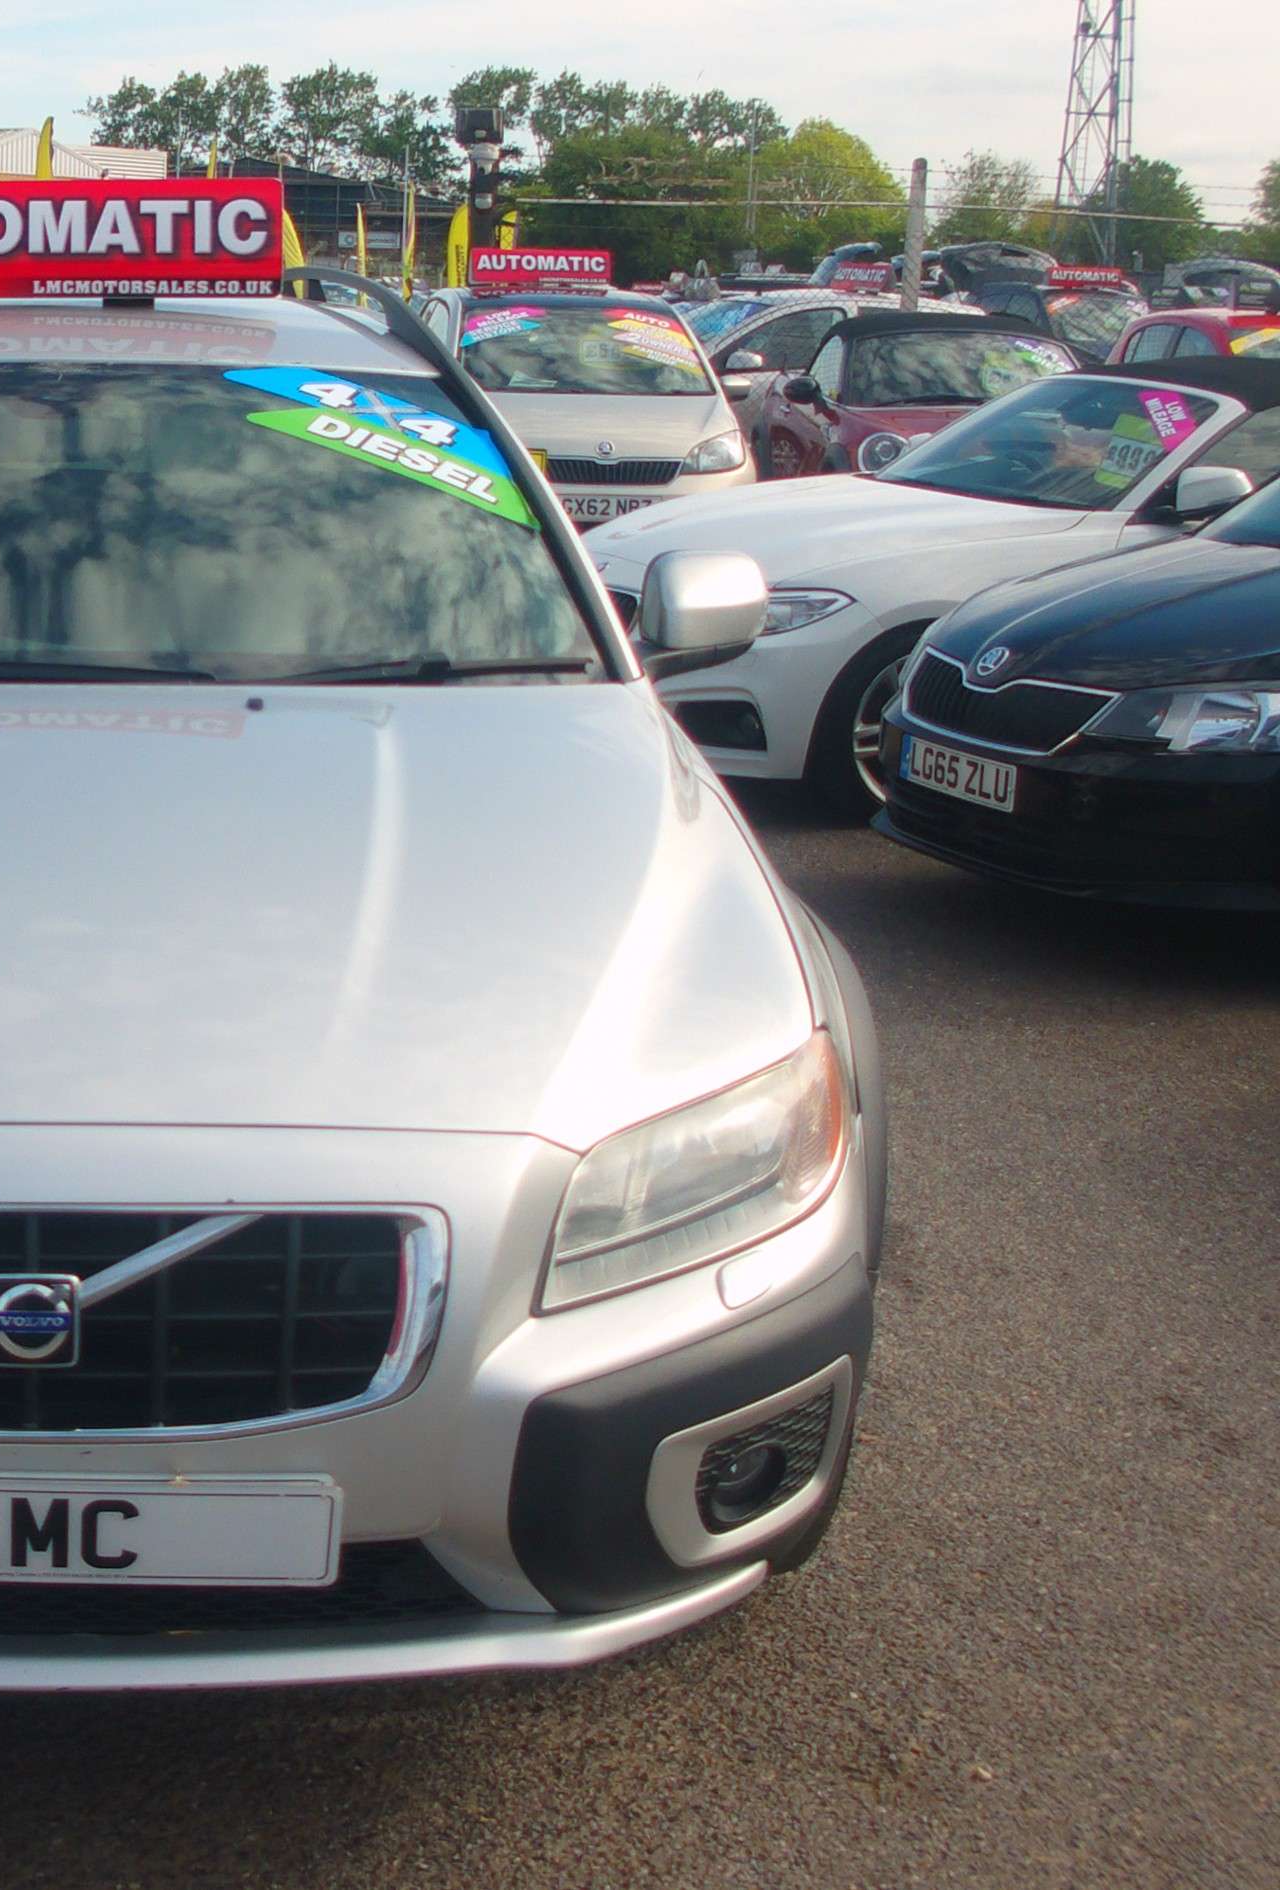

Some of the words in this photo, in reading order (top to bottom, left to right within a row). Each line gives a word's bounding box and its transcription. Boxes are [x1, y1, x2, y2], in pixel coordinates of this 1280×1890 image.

[476, 253, 607, 272] AUTOMATIC
[1051, 269, 1119, 282] AUTOMATIC
[32, 280, 273, 295] LMCMOTORSALES.CO.UK
[623, 311, 671, 329] AUTO
[1144, 397, 1177, 438] MILEAGE
[1164, 401, 1188, 421] LOW
[306, 414, 499, 505] DIESEL
[562, 499, 611, 516] GX62
[910, 742, 960, 790] LG65
[964, 760, 1010, 804] ZLU
